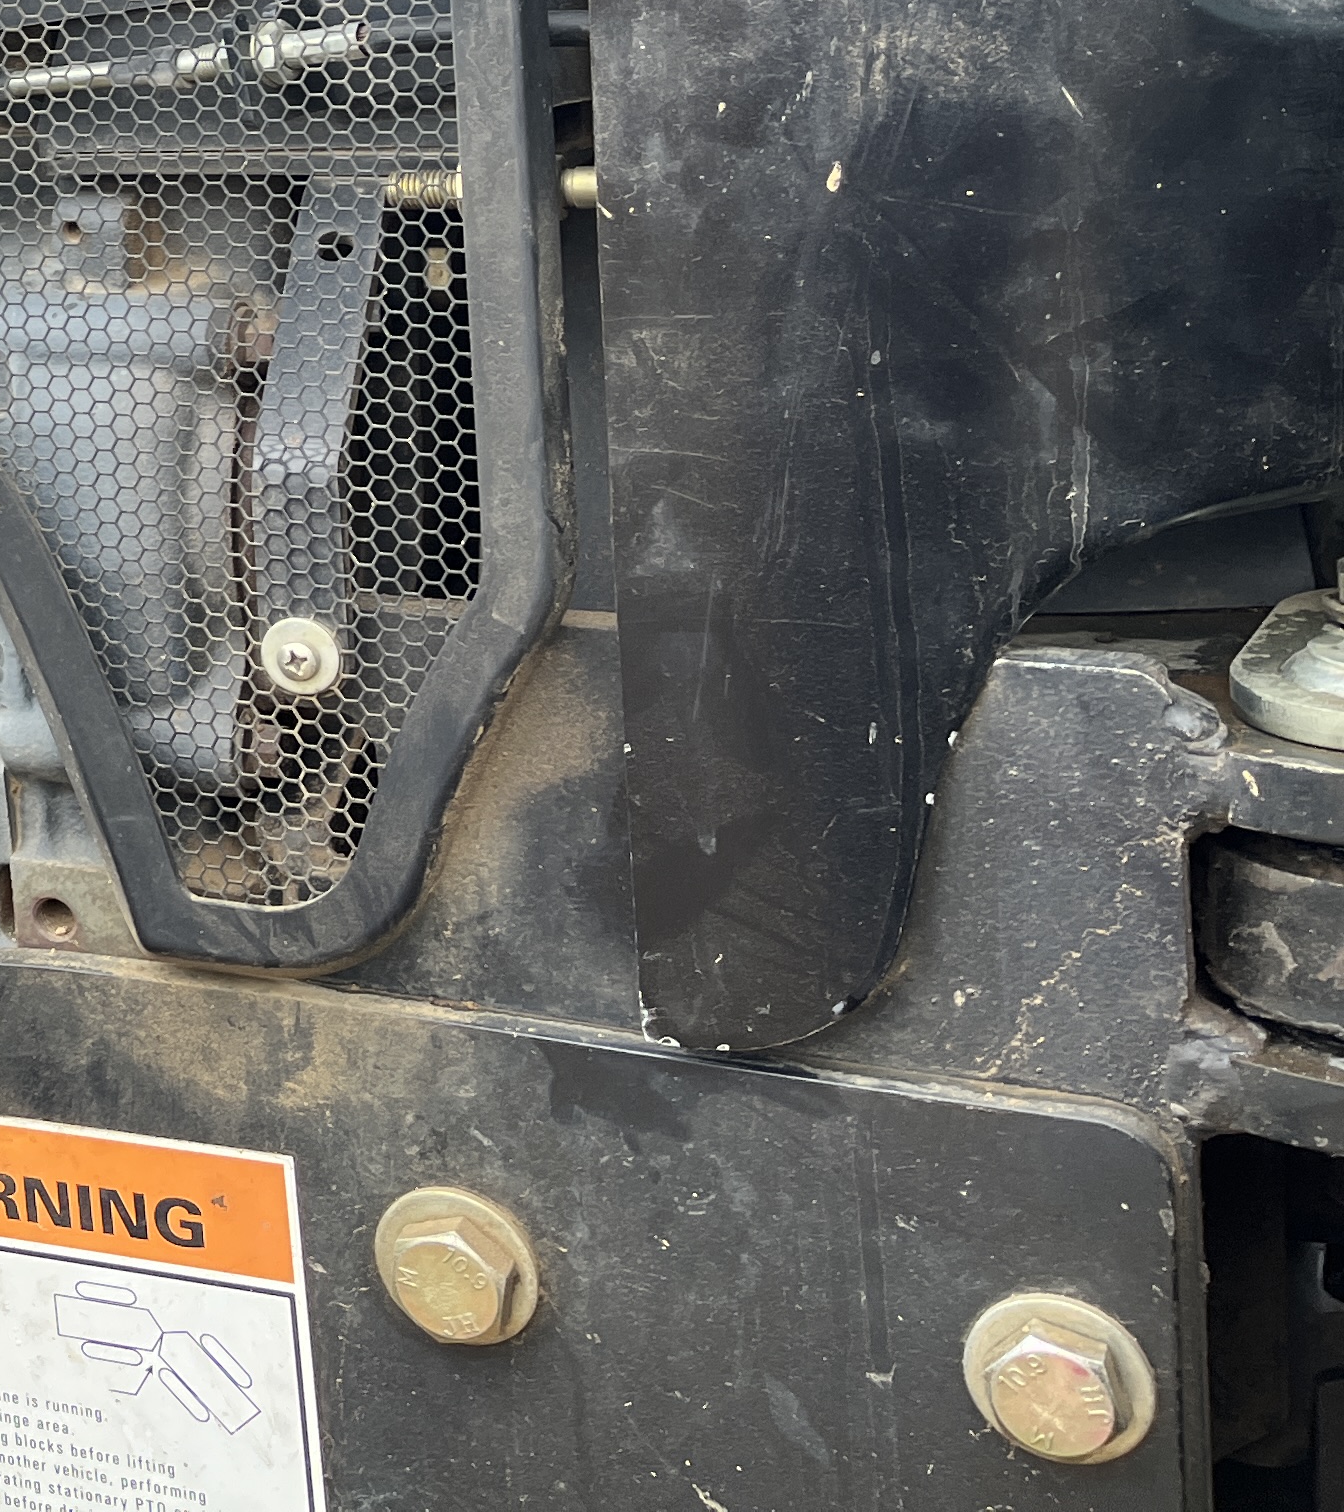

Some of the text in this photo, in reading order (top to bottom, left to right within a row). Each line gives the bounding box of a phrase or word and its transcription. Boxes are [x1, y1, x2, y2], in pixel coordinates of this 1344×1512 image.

[25, 1391, 39, 1409] is
[46, 1400, 108, 1423] running.
[37, 1419, 75, 1436] area.
[15, 1432, 63, 1455] blocks
[70, 1443, 120, 1466] before
[127, 1454, 175, 1479] lifting
[48, 1482, 128, 1512] stationary
[54, 1464, 113, 1487] vehicle,
[120, 1477, 207, 1507] performing
[4, 1492, 52, 1512] before
